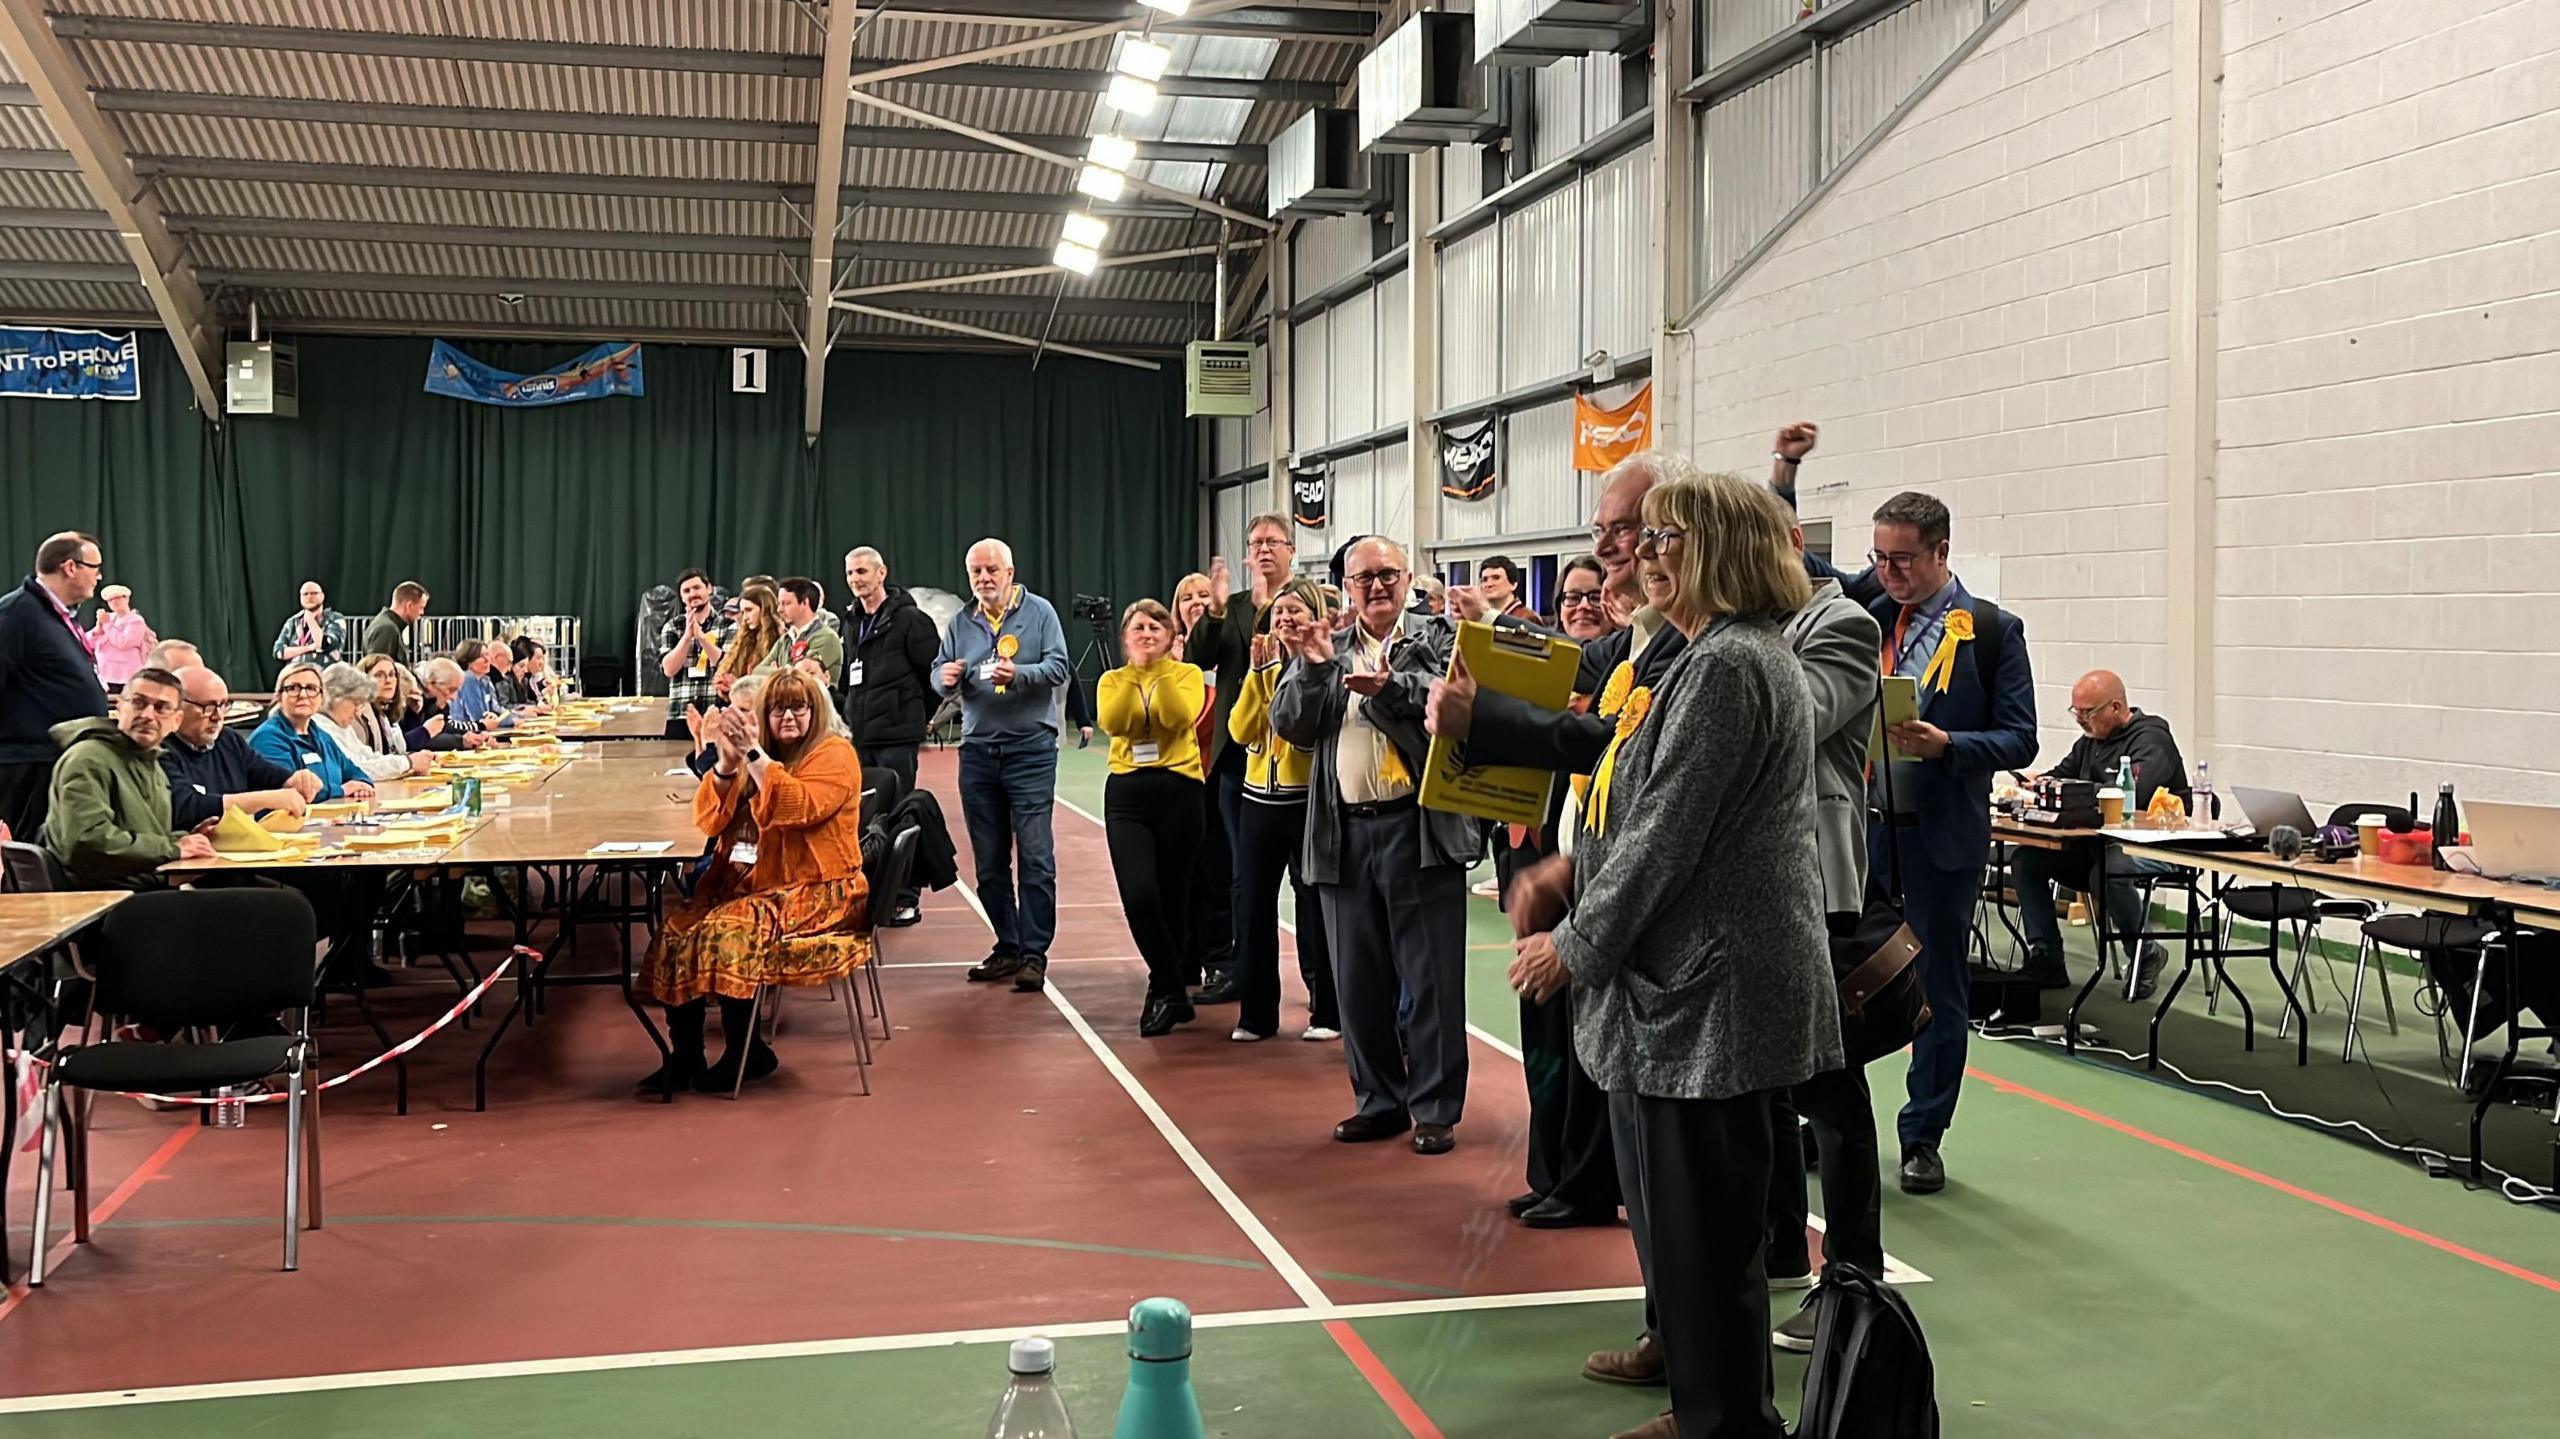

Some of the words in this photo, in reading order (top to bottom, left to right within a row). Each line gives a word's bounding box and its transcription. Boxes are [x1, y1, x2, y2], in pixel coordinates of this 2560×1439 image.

[59, 343, 135, 367] PROVE
[740, 352, 759, 388] 1
[1294, 479, 1325, 503] HEAD
